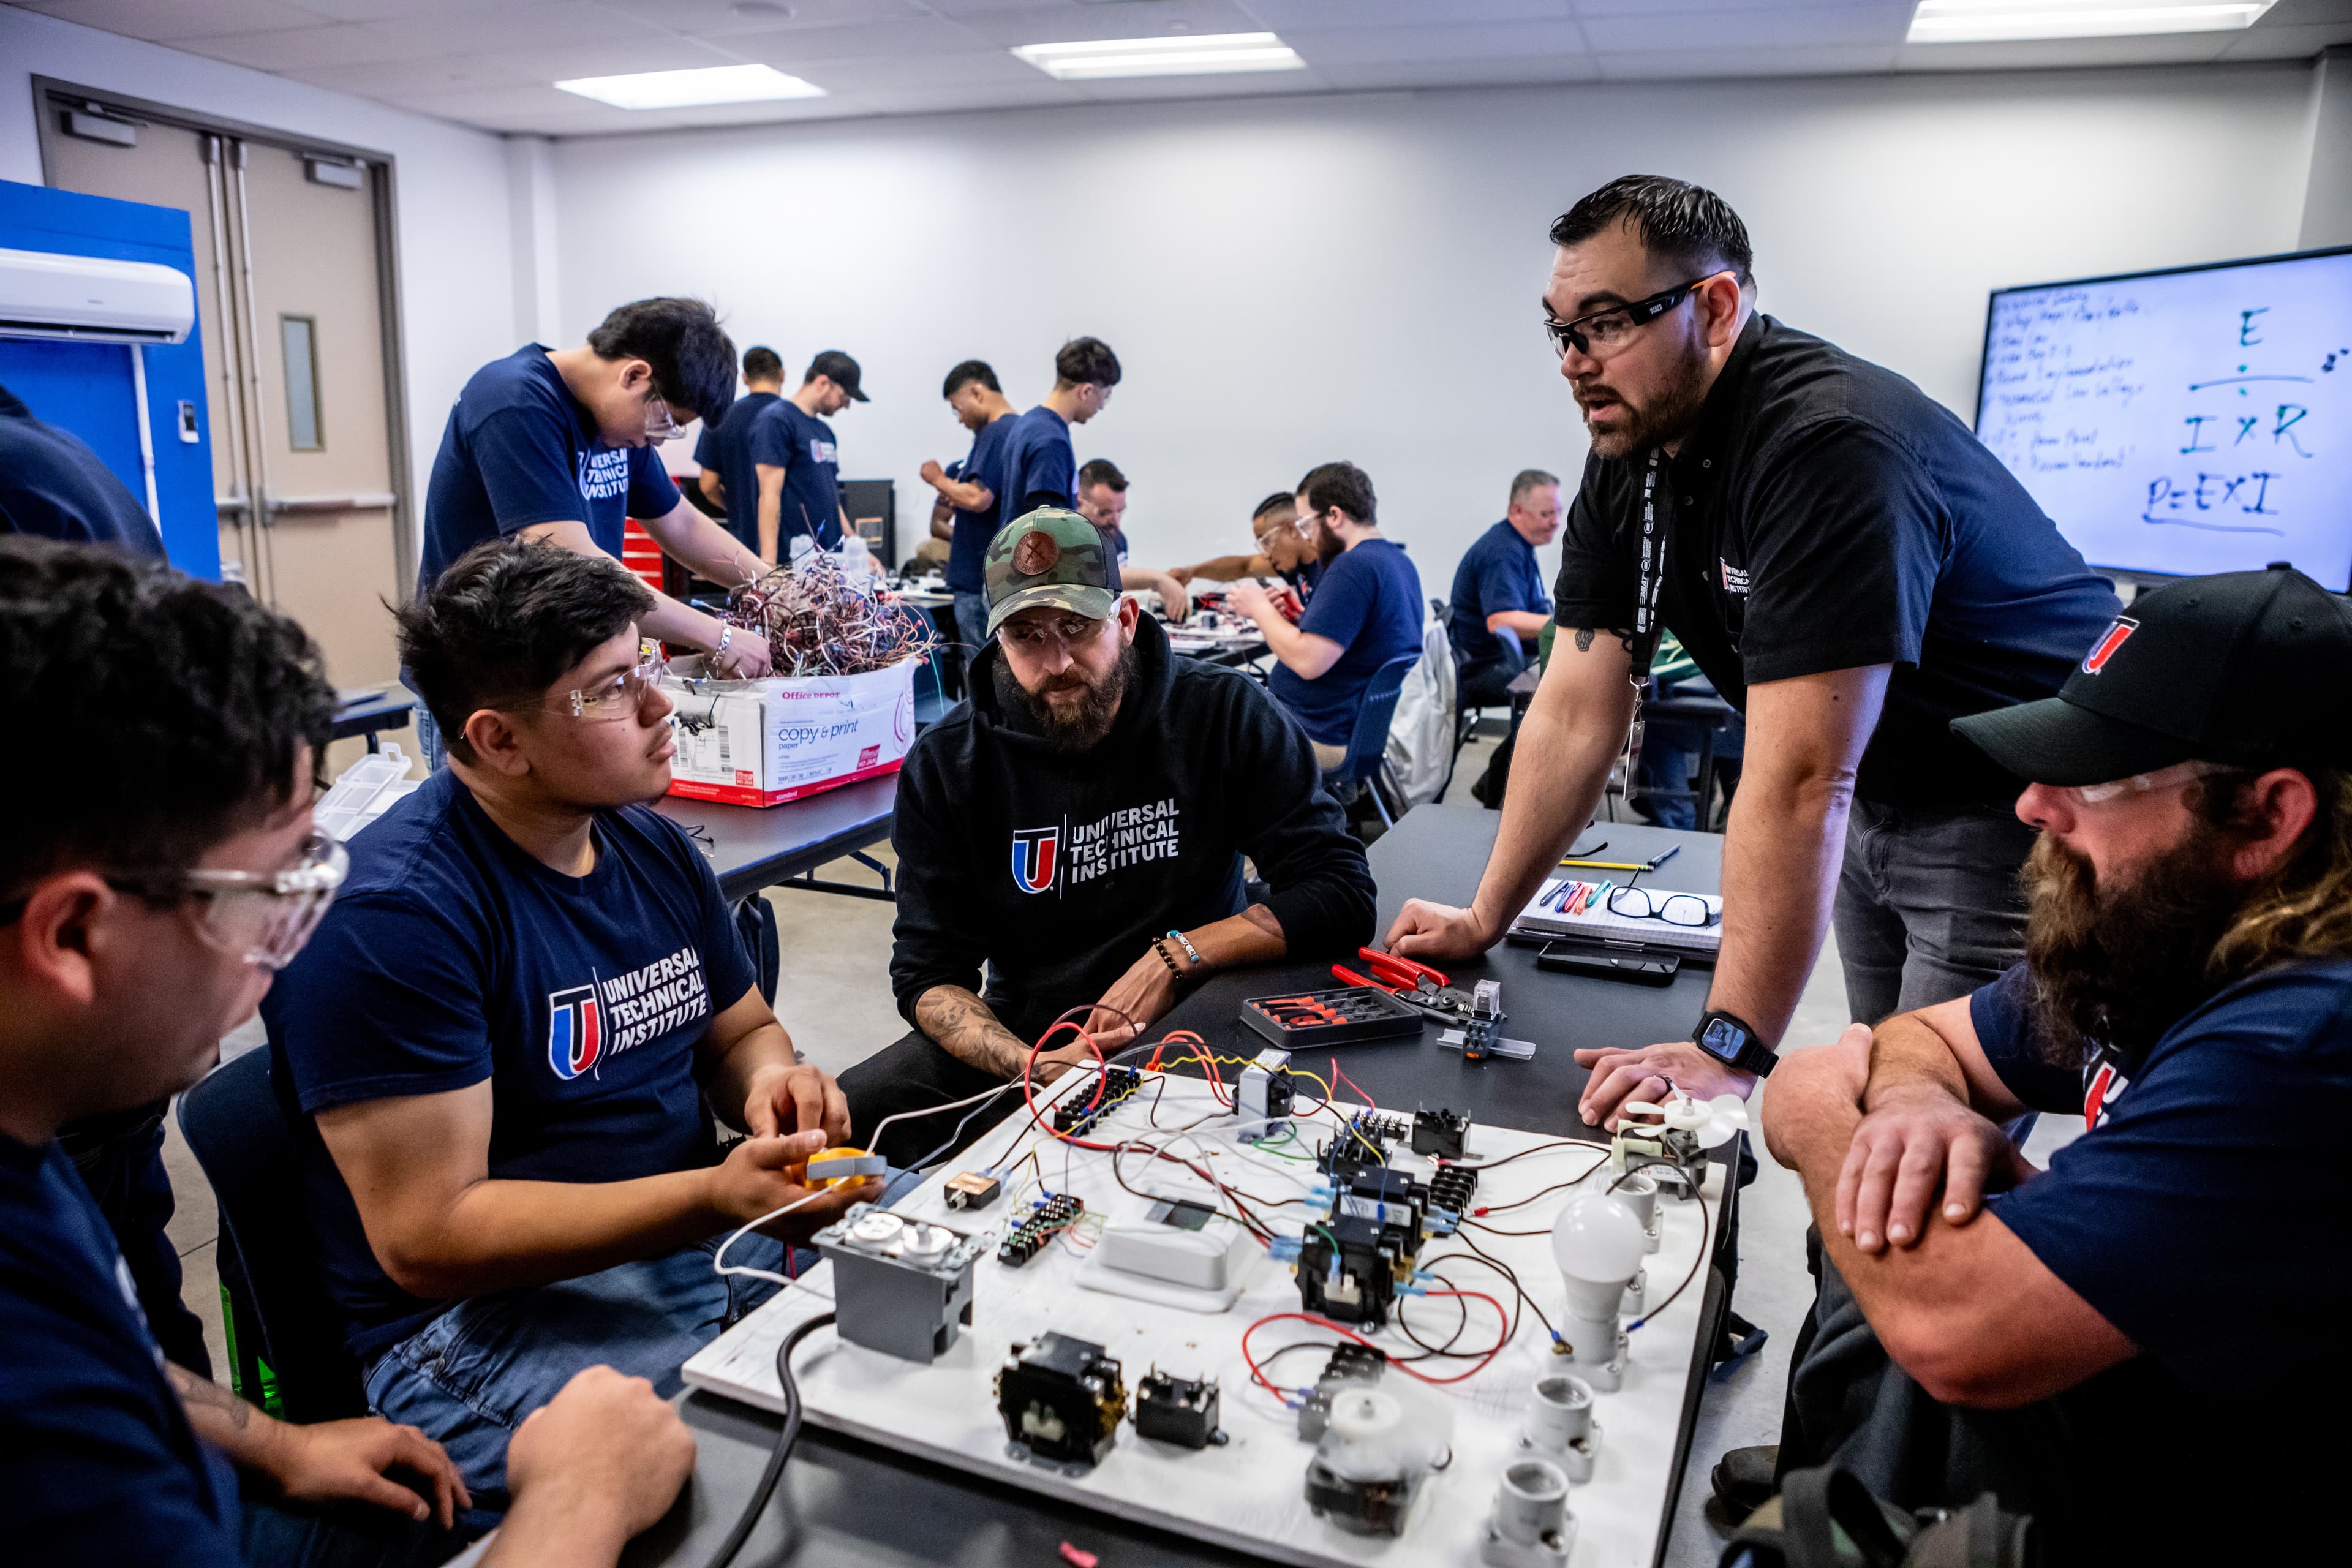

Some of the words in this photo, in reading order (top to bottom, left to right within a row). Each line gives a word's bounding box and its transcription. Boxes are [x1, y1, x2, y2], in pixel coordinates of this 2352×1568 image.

[2241, 307, 2271, 347] E
[2272, 404, 2315, 459] R
[778, 727, 819, 744] copy
[821, 726, 828, 738] &
[830, 718, 859, 741] print
[1070, 818, 1179, 865] TECHNICAL
[1073, 798, 1180, 845] UNIVERSAL
[1072, 838, 1179, 883] INSTITUTE
[603, 946, 700, 1003] UNIVERSAL
[609, 969, 704, 1030] TECHNICAL
[609, 993, 707, 1056] INSTITUTE
